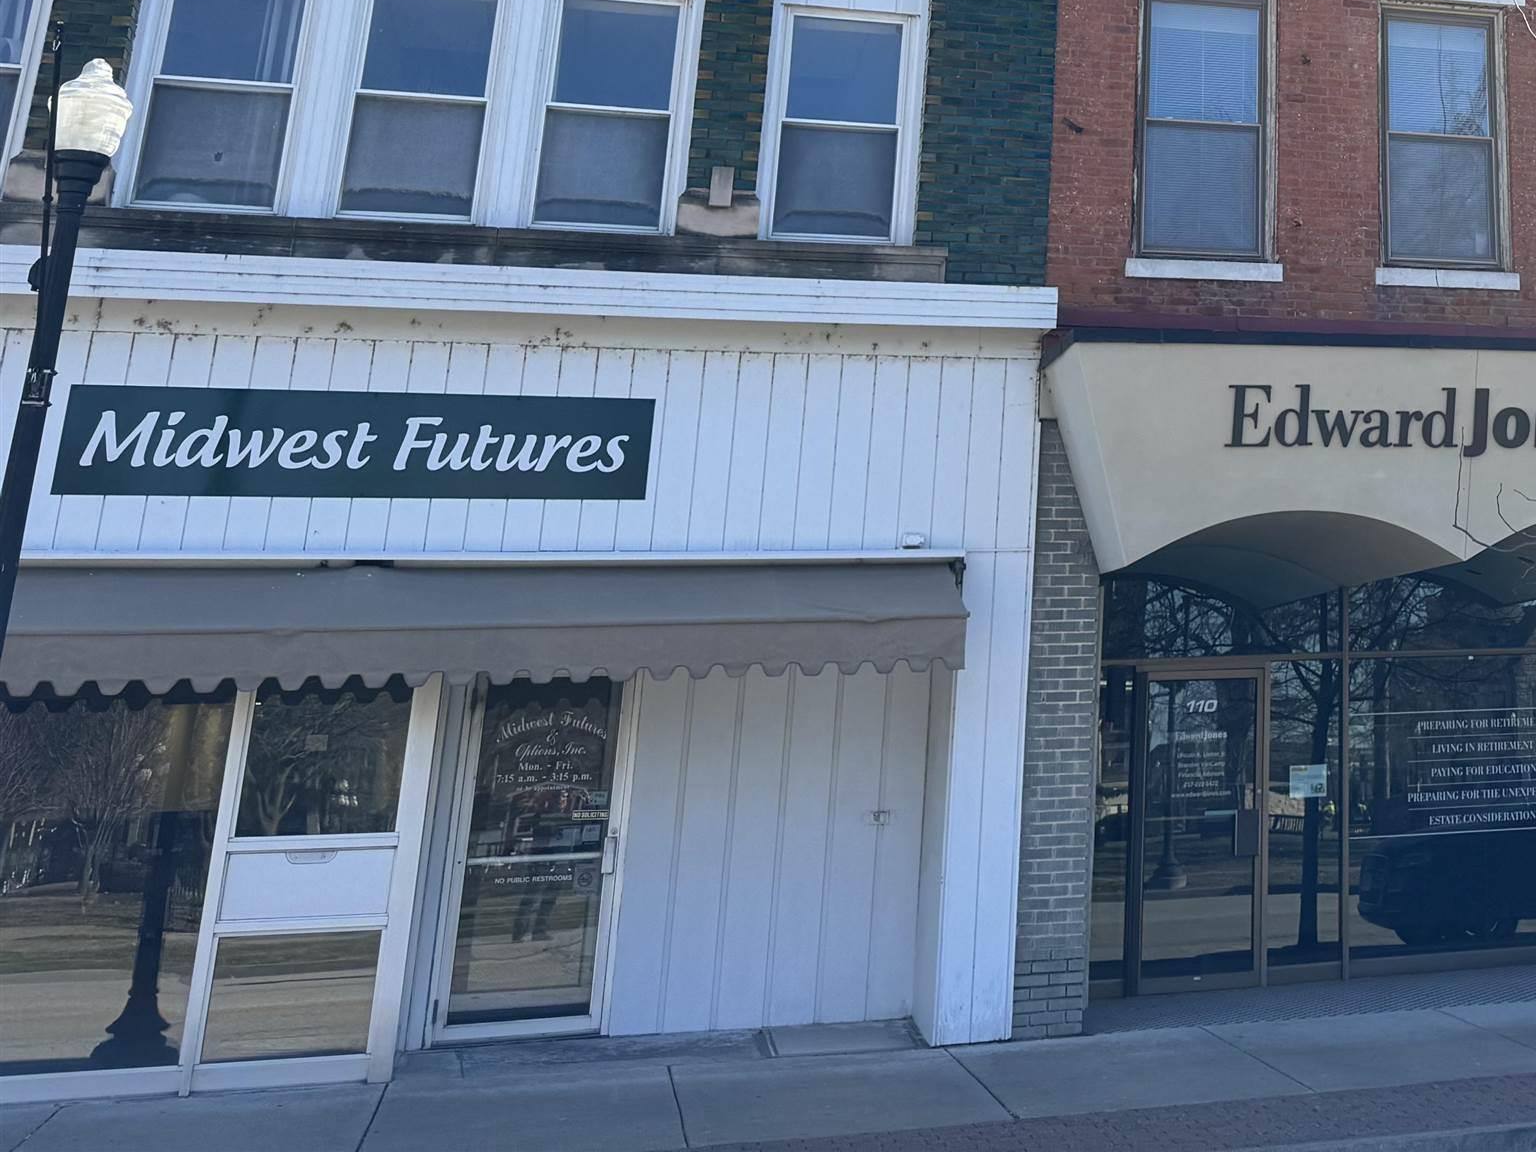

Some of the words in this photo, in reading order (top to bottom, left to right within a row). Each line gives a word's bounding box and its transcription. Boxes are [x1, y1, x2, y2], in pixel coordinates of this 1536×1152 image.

[78, 410, 378, 471] Midwest
[392, 416, 629, 474] Futures
[1186, 699, 1218, 713] 110
[496, 712, 554, 743] Midwest
[560, 711, 607, 740] Futures
[1417, 719, 1468, 731] PREPARING
[1470, 718, 1488, 728] FOR
[546, 729, 558, 745] &
[515, 744, 560, 762] Options,
[561, 743, 587, 755] Inc.
[1432, 743, 1463, 753] LIVING
[1465, 742, 1476, 752] IN
[1477, 740, 1534, 752] RETIREMENT
[518, 762, 542, 771] Mon.
[555, 761, 573, 770] Fri.
[1431, 766, 1463, 777] PAYING
[1466, 766, 1484, 776] FOR
[1486, 764, 1536, 775] EDUCATION
[496, 774, 514, 783] 7:15
[550, 773, 569, 782] 3:15
[572, 774, 592, 783] p.m.
[1407, 791, 1459, 802] PREPARING
[1461, 790, 1480, 800] FOR
[1481, 789, 1500, 799] THE
[1429, 814, 1461, 825] ESTATE
[532, 874, 573, 882] RESTROOMS
